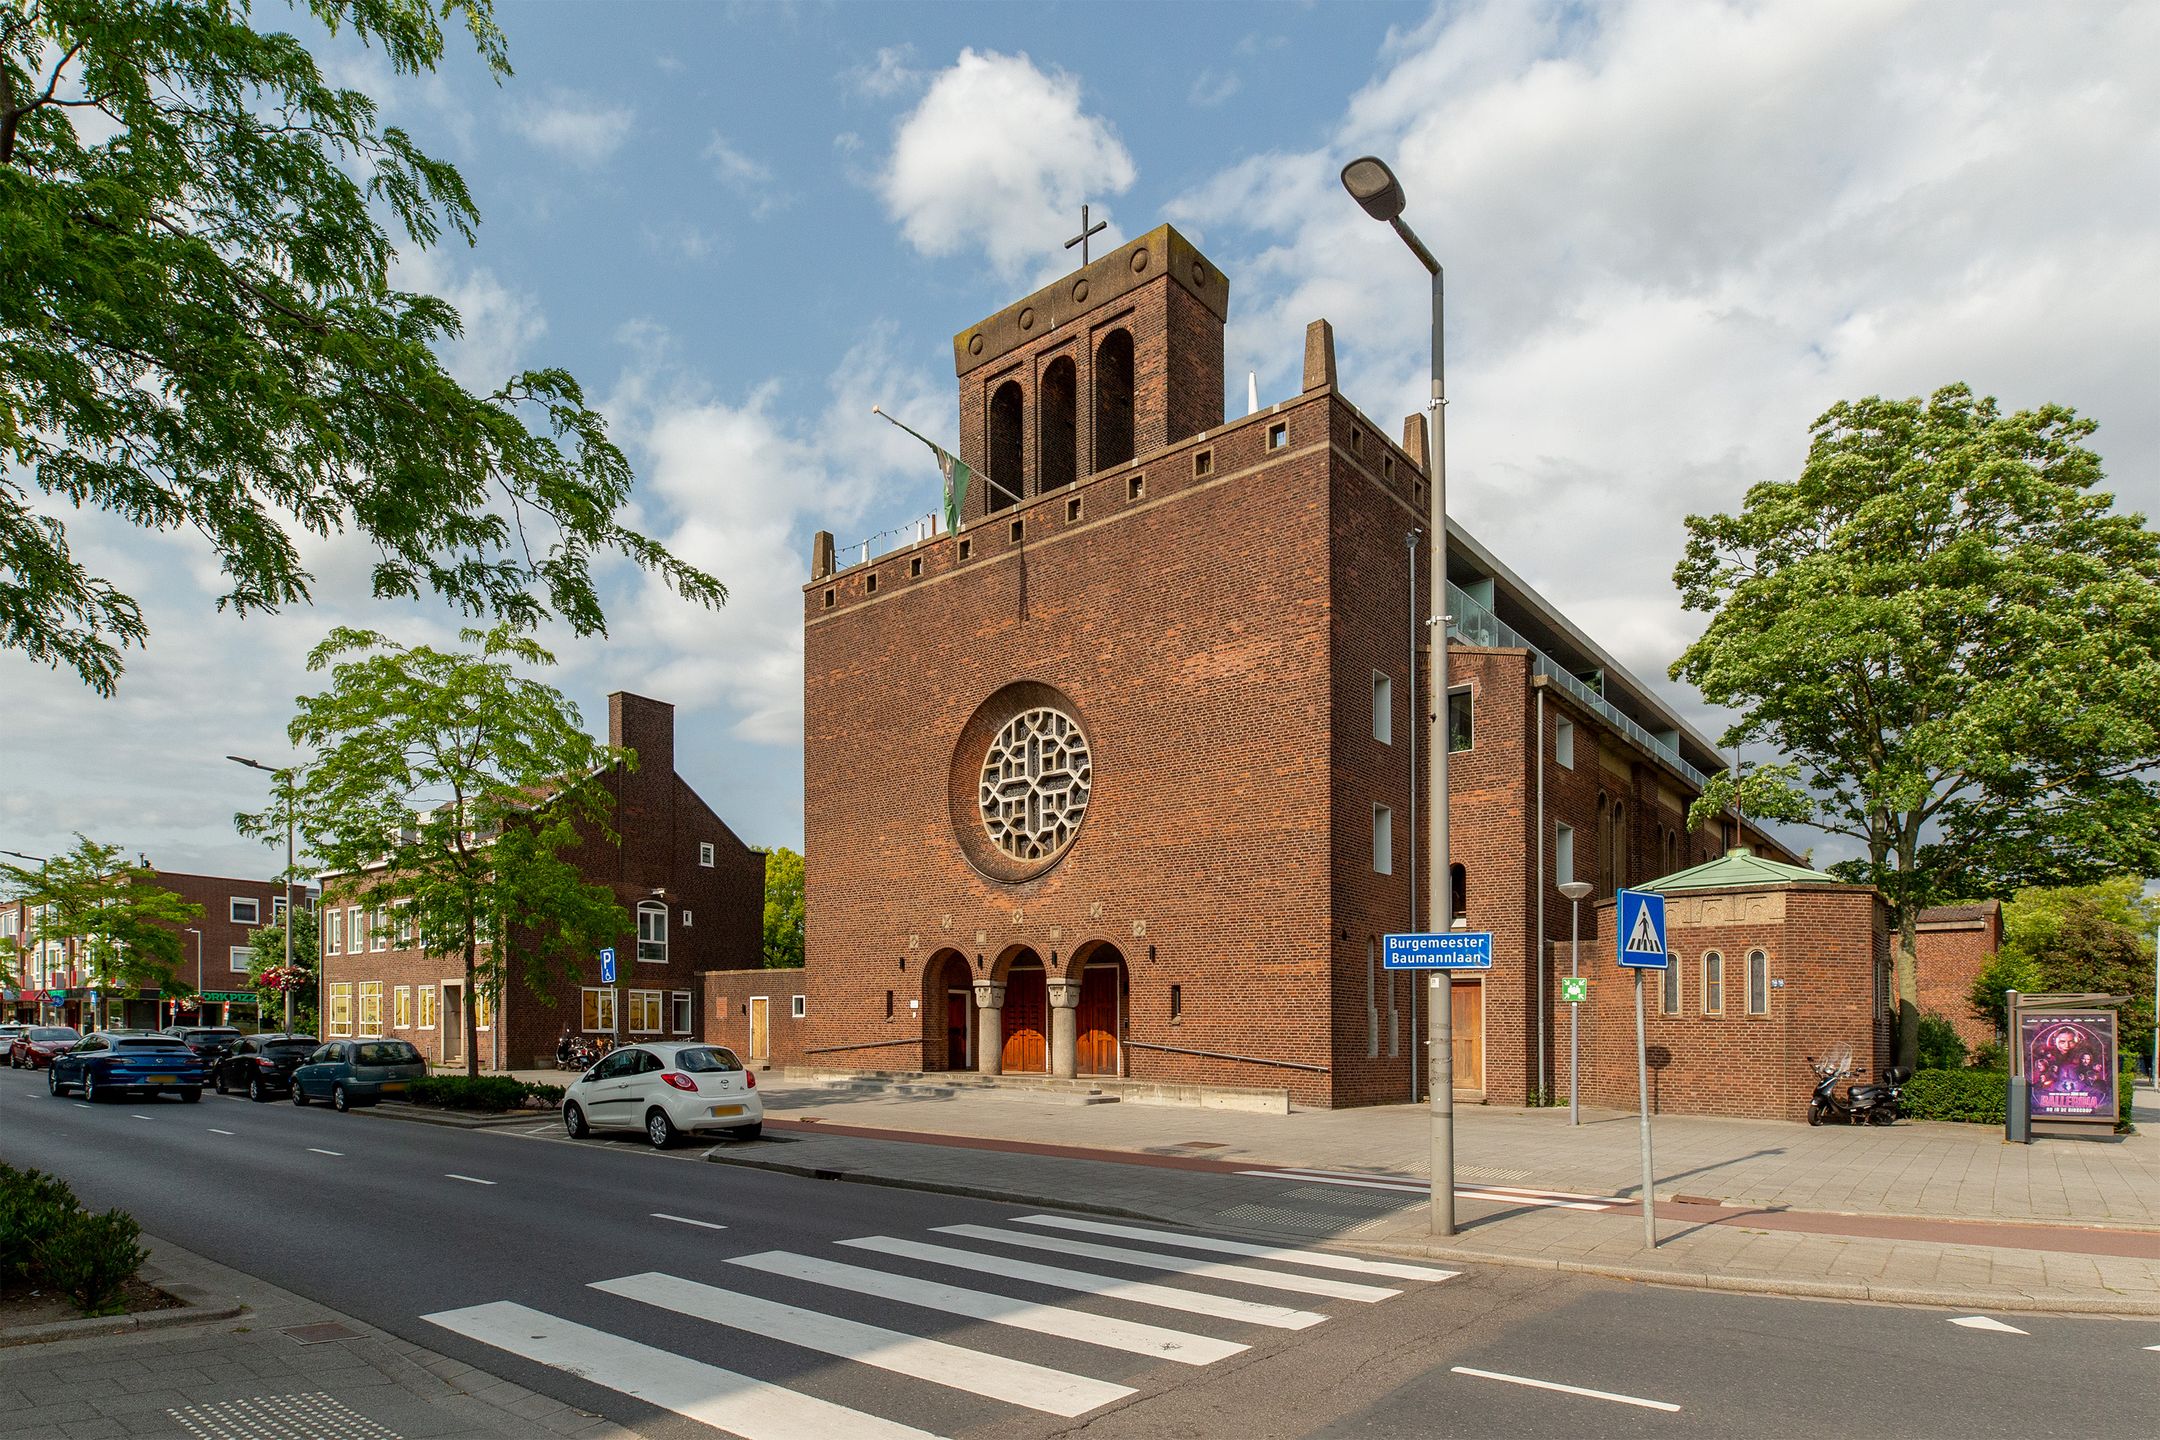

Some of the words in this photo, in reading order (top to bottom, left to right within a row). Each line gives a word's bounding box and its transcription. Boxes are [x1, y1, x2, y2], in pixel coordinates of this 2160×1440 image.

[1390, 937, 1484, 951] Burgemeester
[603, 952, 611, 969] P
[1392, 951, 1481, 964] Baumannlaan
[229, 993, 257, 1002] PIZZ
